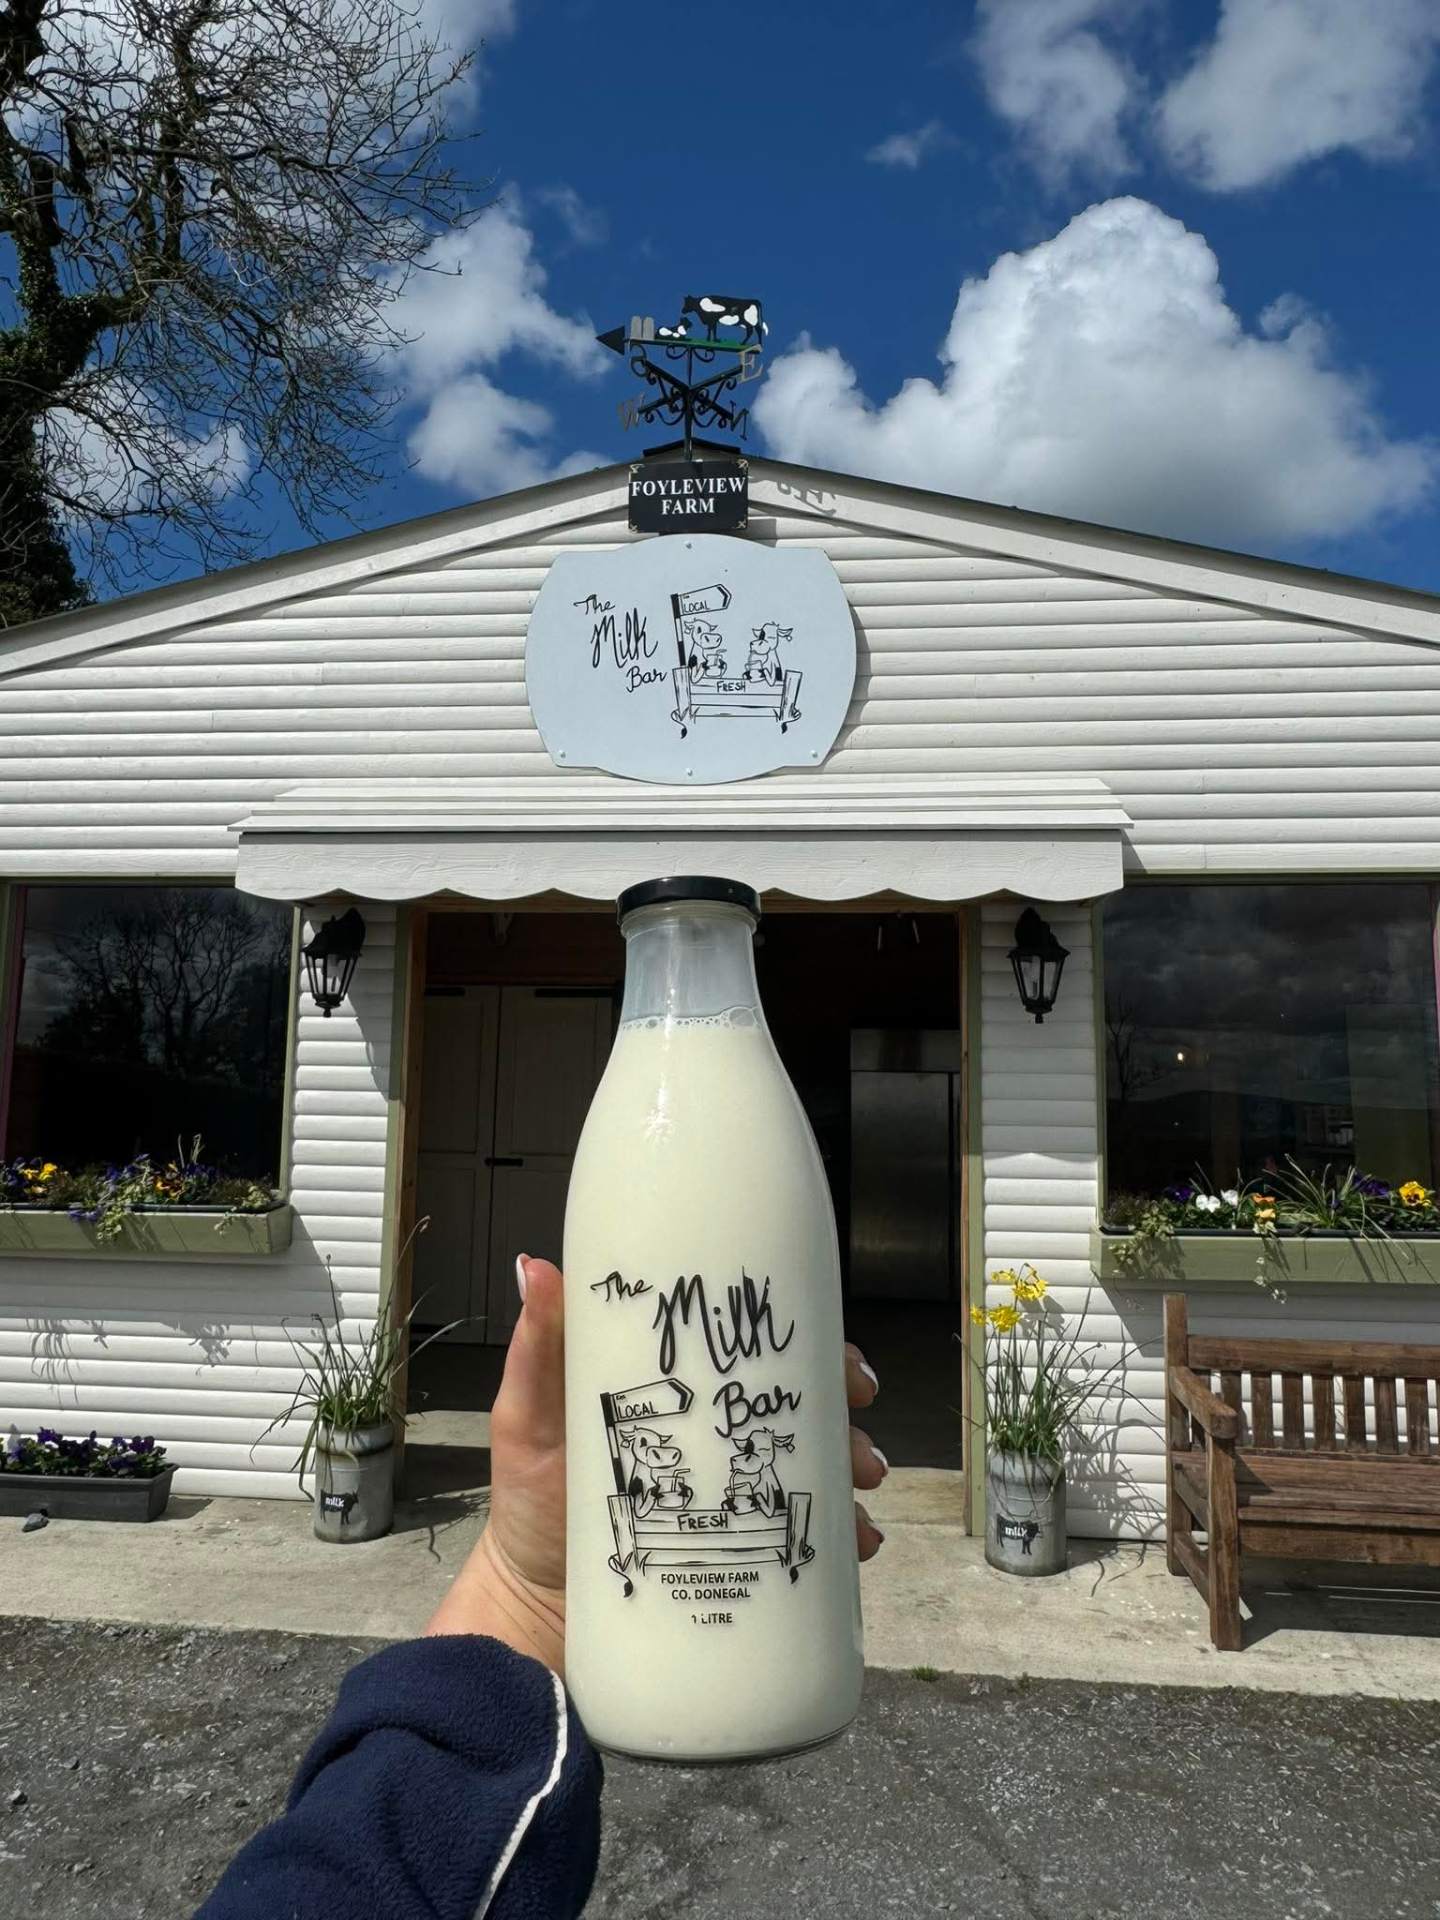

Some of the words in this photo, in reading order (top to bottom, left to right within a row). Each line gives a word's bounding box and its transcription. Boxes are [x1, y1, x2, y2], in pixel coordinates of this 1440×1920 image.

[631, 477, 746, 496] FOYLEVIEW
[661, 498, 715, 515] FARM
[573, 593, 616, 616] The
[683, 600, 711, 613] LOCAL
[590, 607, 659, 669] Milk
[626, 666, 668, 693] Bar
[716, 680, 747, 693] FRESH
[590, 1270, 654, 1303] The
[652, 1265, 795, 1376] Milk
[617, 1400, 660, 1420] LOCAL
[712, 1380, 803, 1439] Bar
[677, 1512, 729, 1532] FRESH
[661, 1573, 724, 1584] FOYLEVIEW
[728, 1571, 760, 1583] FARM
[671, 1588, 692, 1601] CO.
[695, 1587, 751, 1600] DONEGAL
[701, 1613, 733, 1624] LITRE
